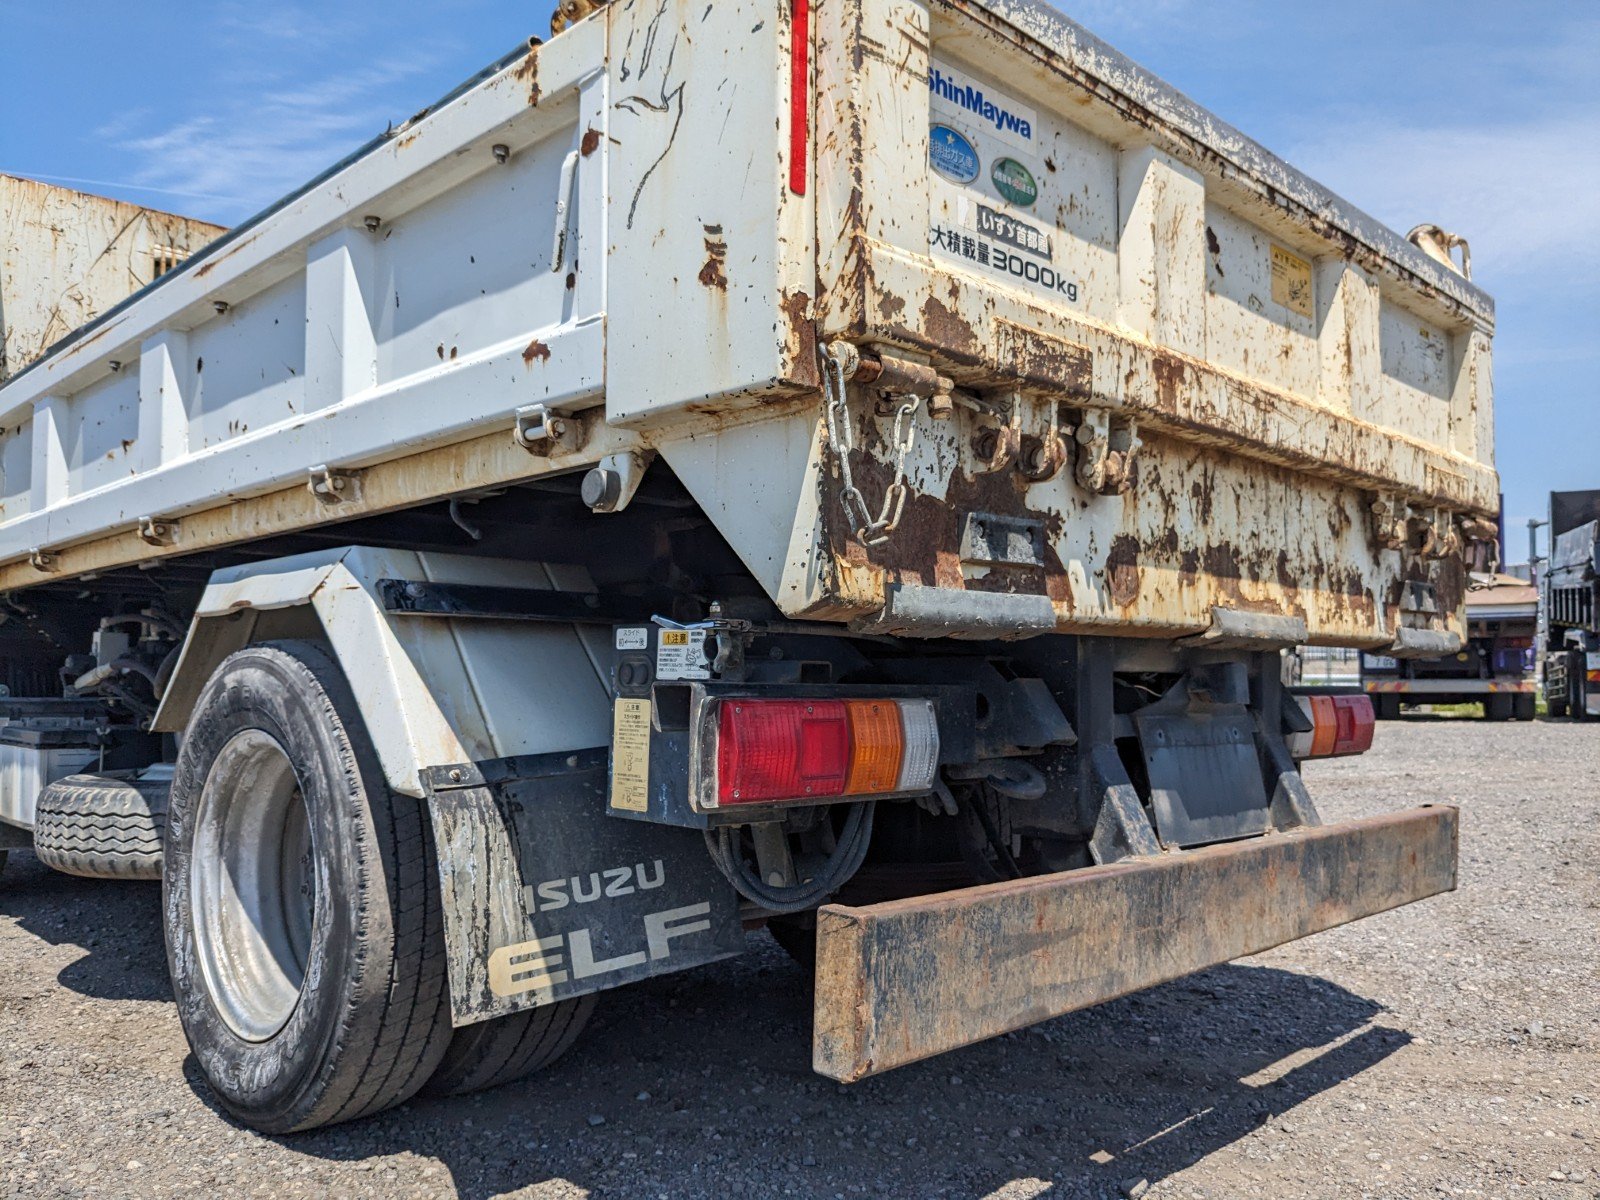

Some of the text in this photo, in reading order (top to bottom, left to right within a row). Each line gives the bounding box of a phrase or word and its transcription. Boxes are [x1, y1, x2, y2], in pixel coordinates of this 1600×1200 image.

[928, 224, 1077, 302] 大積載量3000kg
[671, 633, 687, 644] 注意
[524, 859, 666, 915] ISUZU
[487, 901, 711, 998] ELF
